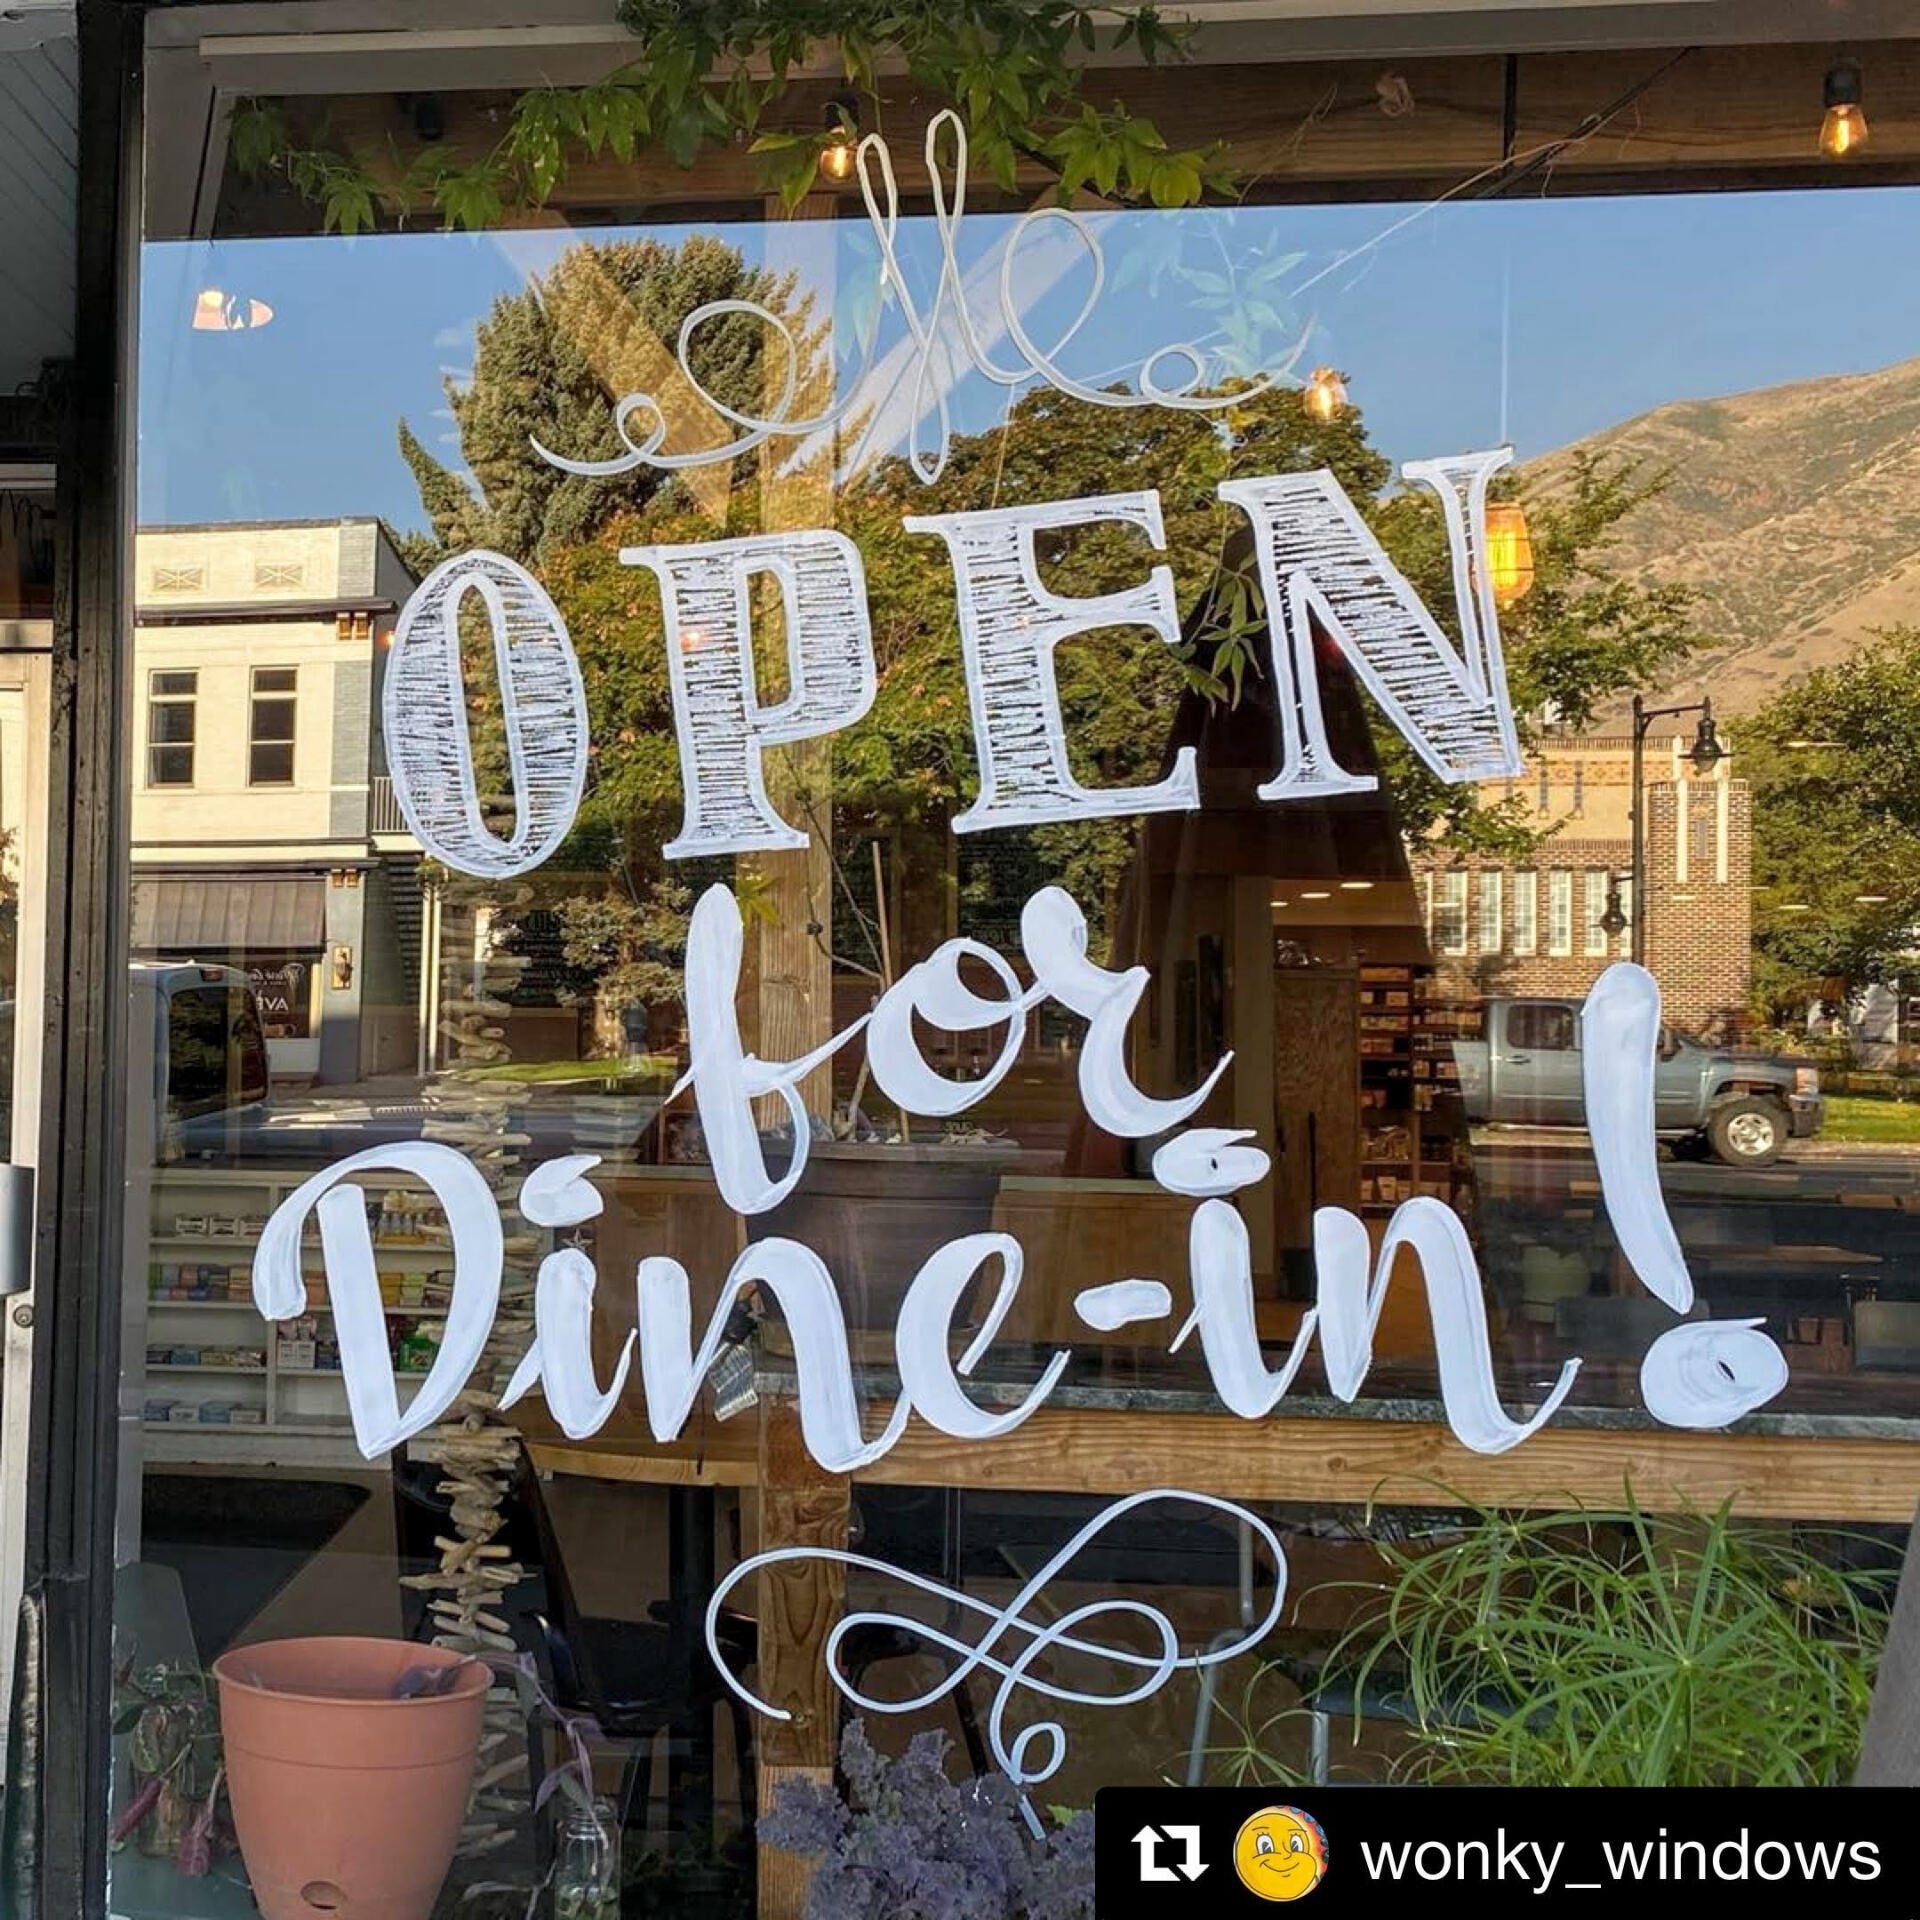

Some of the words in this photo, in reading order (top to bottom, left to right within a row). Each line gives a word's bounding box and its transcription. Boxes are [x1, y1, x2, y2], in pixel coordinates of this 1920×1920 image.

[382, 445, 1524, 880] OPEN
[255, 961, 1790, 1472] Dine-in!
[666, 883, 1235, 1215] for
